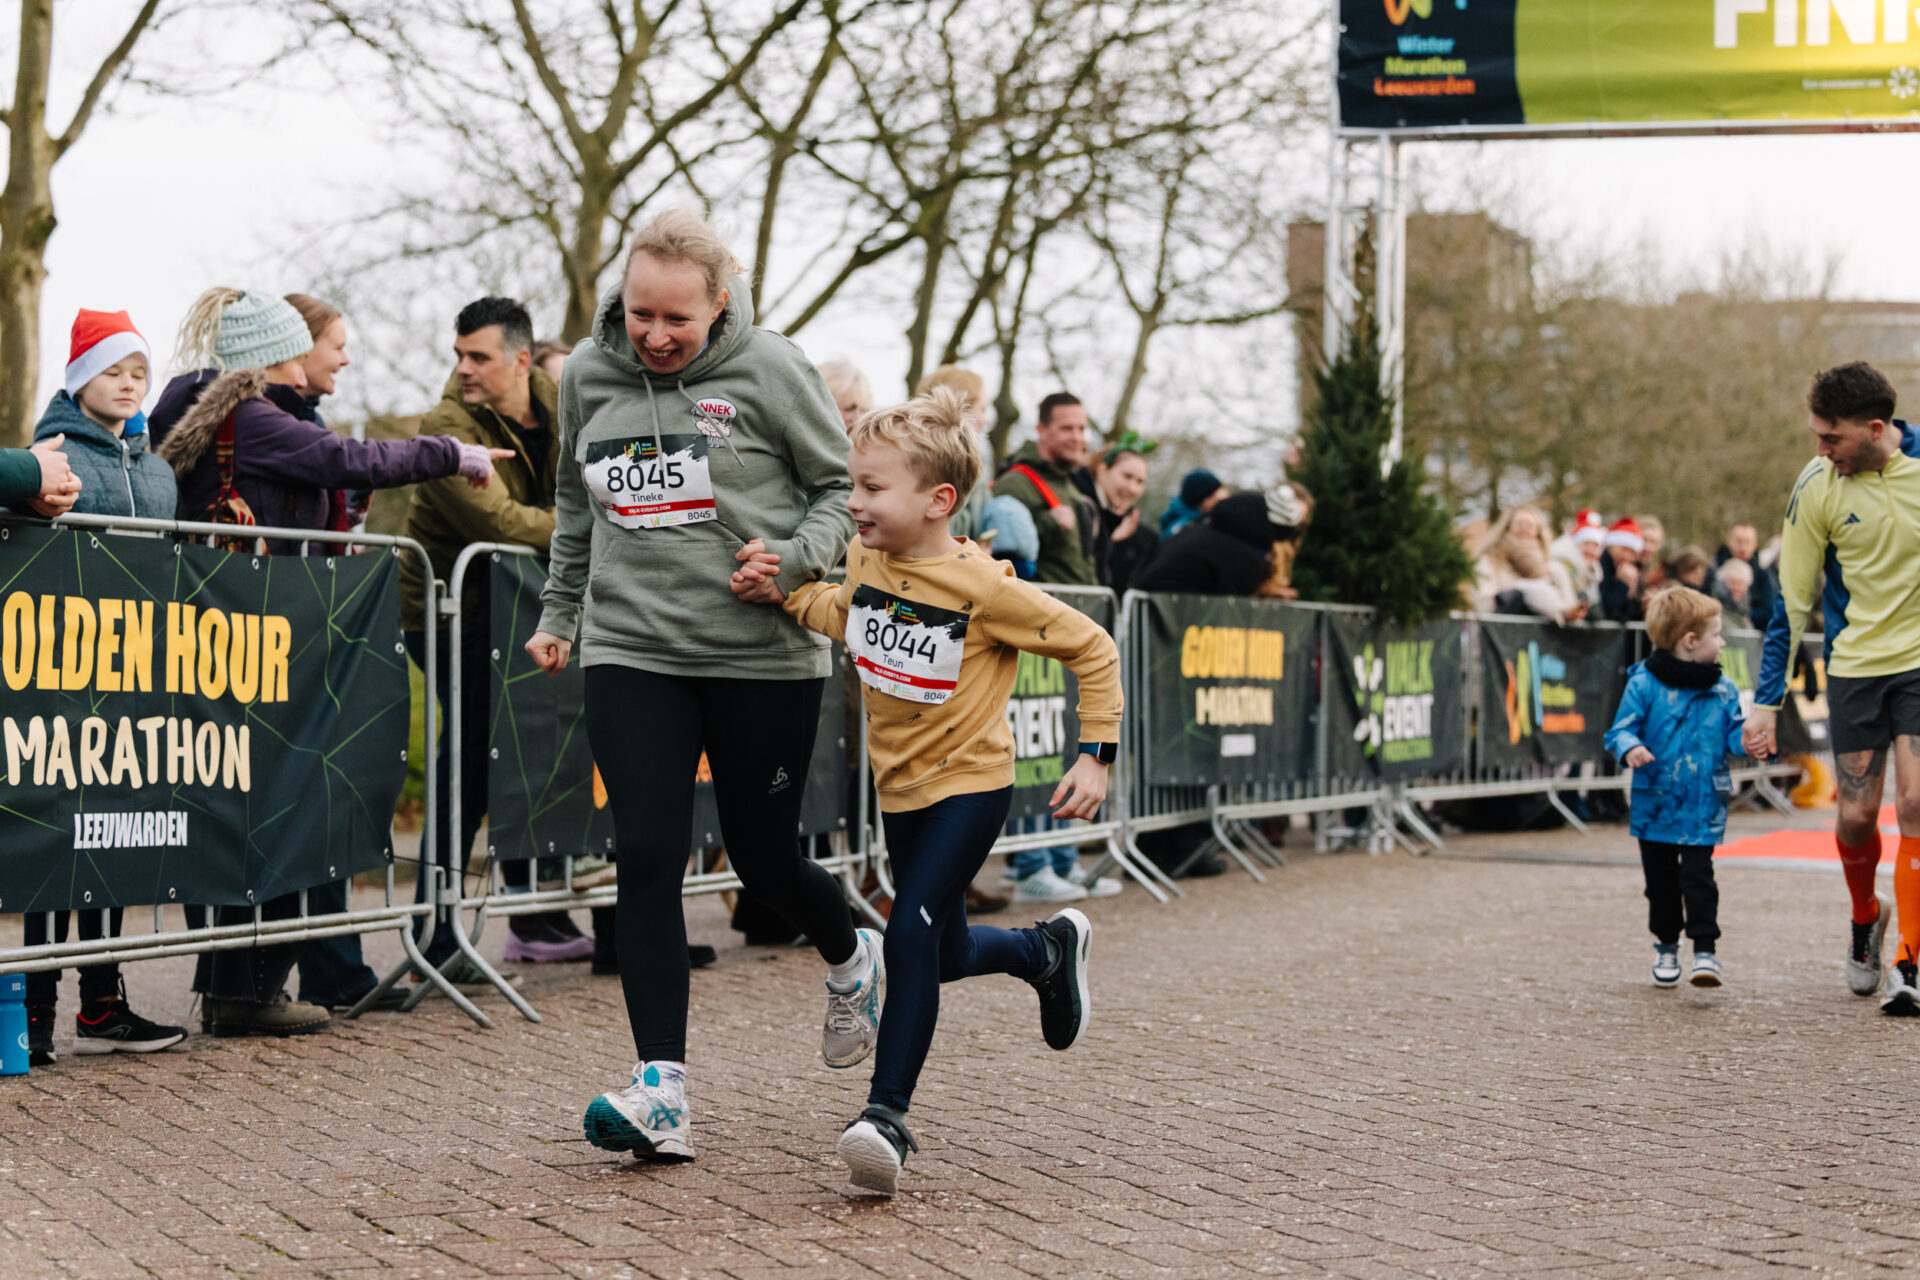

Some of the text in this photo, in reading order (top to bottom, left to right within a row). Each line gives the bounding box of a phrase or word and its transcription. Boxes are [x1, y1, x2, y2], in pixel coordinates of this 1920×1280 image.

[1714, 0, 1920, 48] FINI
[1397, 34, 1455, 54] Winter
[1384, 56, 1466, 75] Marathon
[1374, 75, 1475, 96] Leeuwarden
[607, 462, 684, 493] 8045
[631, 493, 664, 503] Tineke
[687, 510, 711, 520] 8045
[166, 602, 292, 703] HOUR
[865, 618, 937, 664] 8044
[882, 654, 904, 669] Teun
[3, 715, 251, 793] MARATHON
[73, 811, 188, 850] LEEUWARDEN
